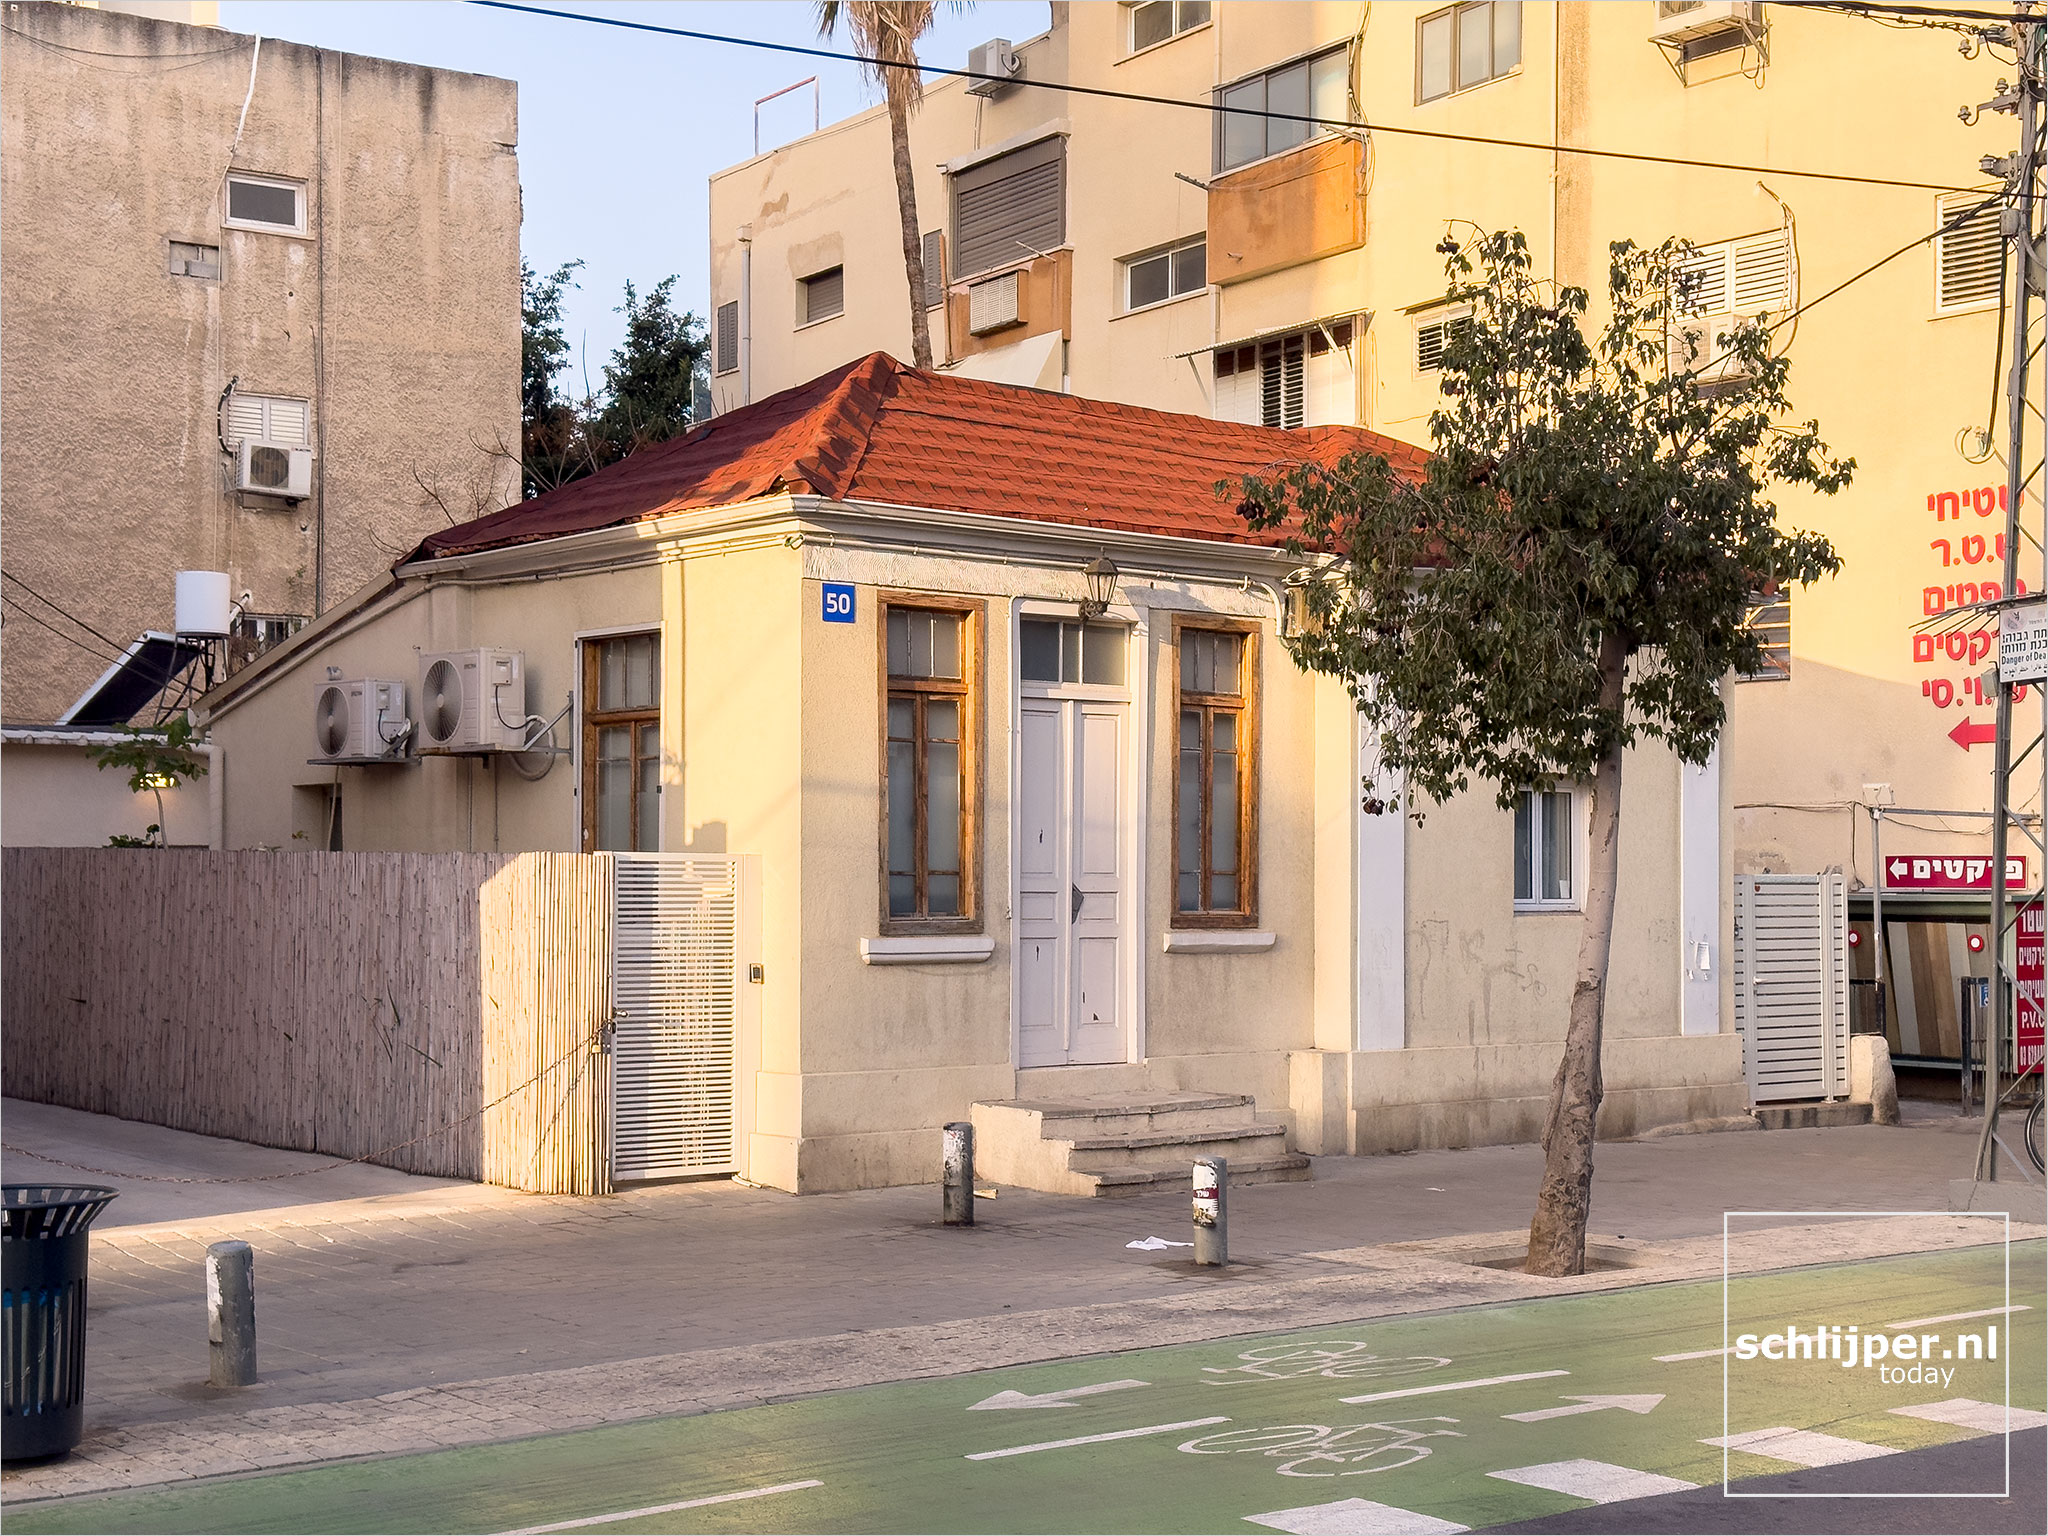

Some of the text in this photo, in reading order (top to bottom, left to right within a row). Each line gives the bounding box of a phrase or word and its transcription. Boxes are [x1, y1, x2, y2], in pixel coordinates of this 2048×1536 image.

[827, 592, 850, 614] 50
[1912, 630, 1999, 665] קטים
[2002, 656, 2024, 665] Danger
[2026, 653, 2032, 661] of
[1912, 860, 2023, 885] פקטים
